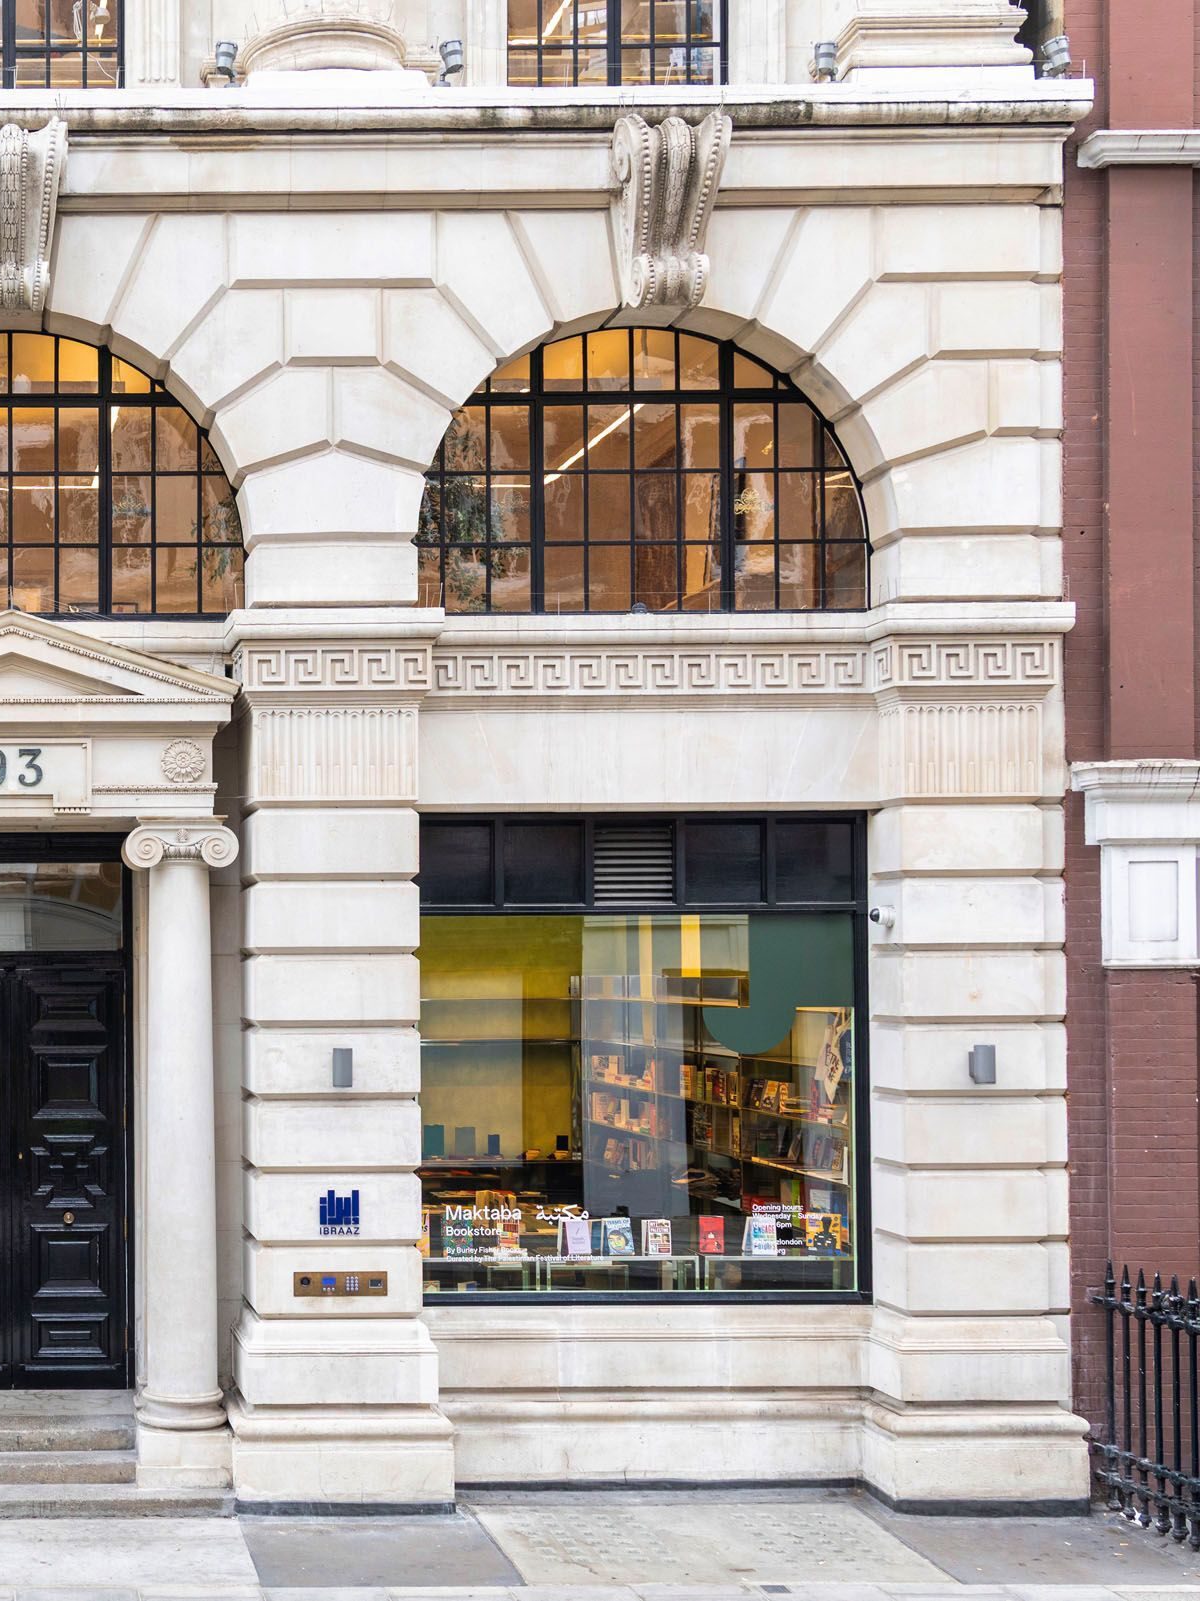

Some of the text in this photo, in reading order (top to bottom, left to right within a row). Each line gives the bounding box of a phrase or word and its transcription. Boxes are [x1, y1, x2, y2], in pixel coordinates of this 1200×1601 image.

[445, 1204, 522, 1221] Maktaba
[752, 1204, 781, 1212] Opening
[535, 1203, 590, 1225] مكتبة
[319, 1226, 360, 1235] IBRAAZ
[445, 1225, 503, 1237] Bookstore
[446, 1246, 455, 1254] By
[456, 1246, 478, 1255] Burley
[474, 1255, 483, 1263] by
[536, 1254, 562, 1262] Festival
